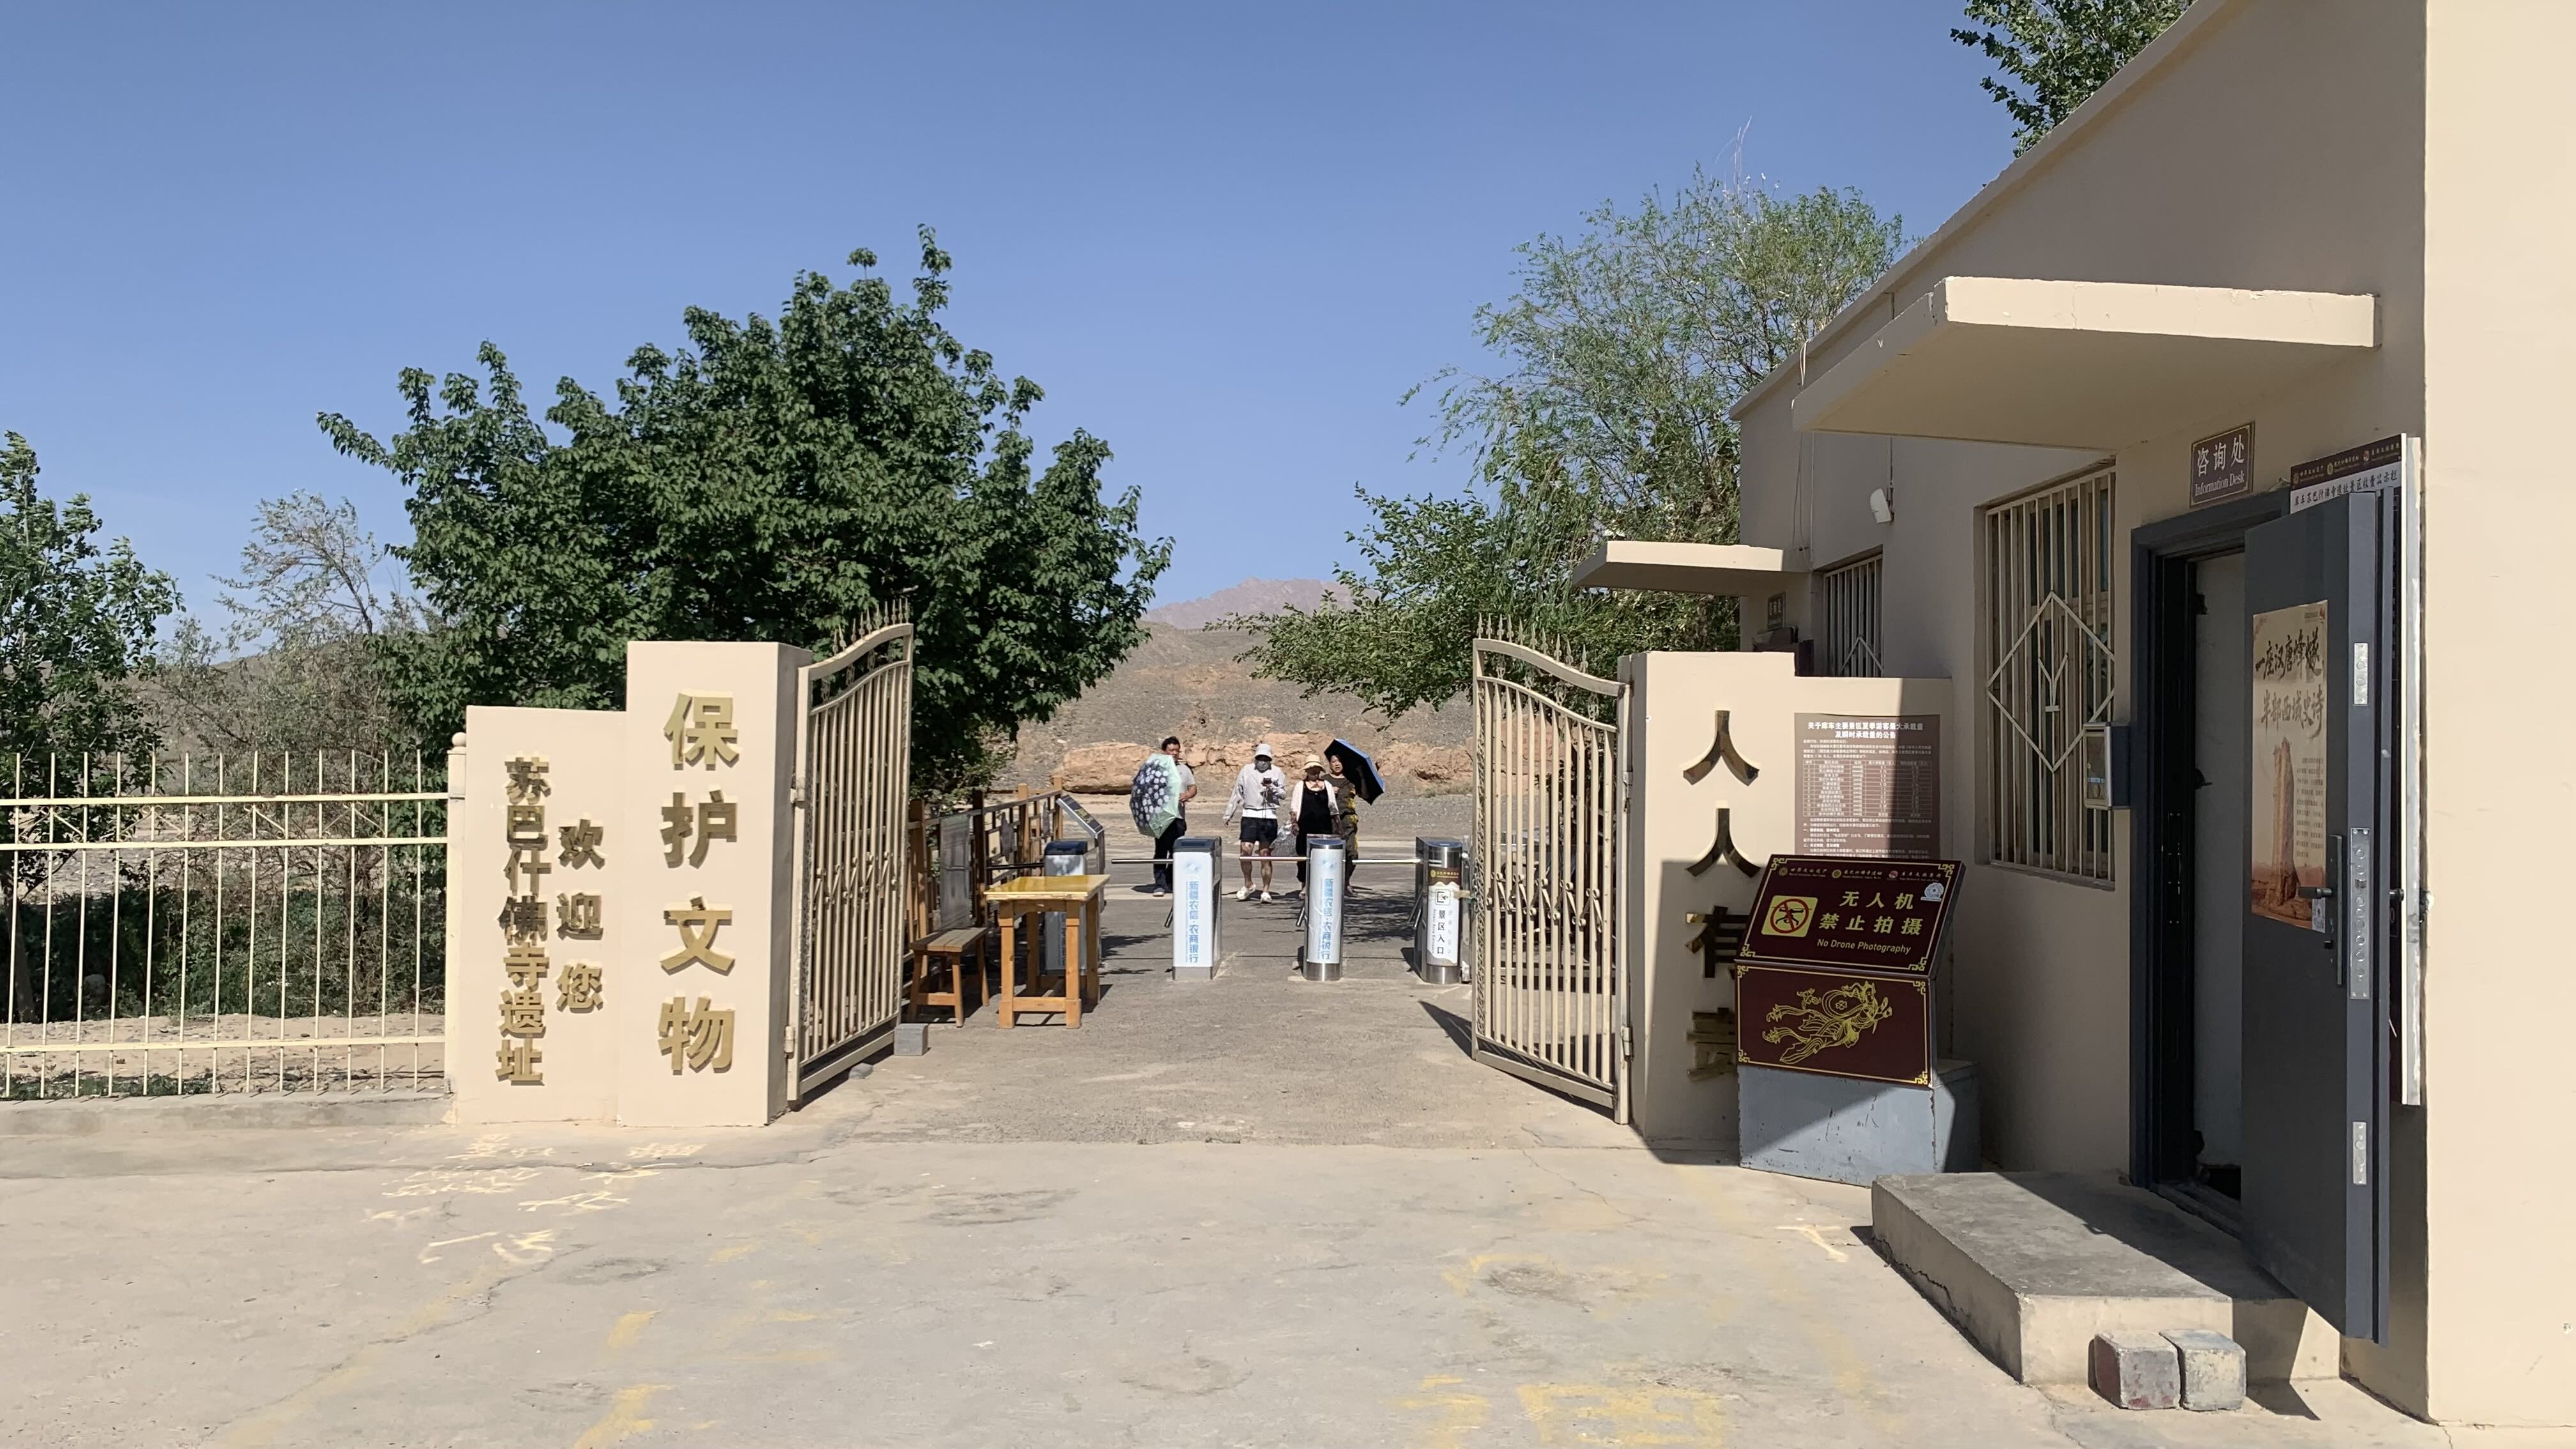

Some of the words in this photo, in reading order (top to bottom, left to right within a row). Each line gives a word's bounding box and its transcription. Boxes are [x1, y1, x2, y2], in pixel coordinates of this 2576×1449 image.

[2196, 434, 2244, 477] 咨询处
[2195, 477, 2229, 496] Information
[2230, 470, 2244, 486] Desk
[1807, 722, 1924, 731] 关于库车主要景区夏季游客最大承载量
[2261, 684, 2324, 739] 半部西域史诗
[659, 689, 742, 1075] 保护文物
[1839, 891, 1913, 910] 无人机
[496, 752, 551, 1085] 苏巴什佛寺遗址
[556, 813, 606, 1013] 欢迎您
[1437, 910, 1445, 954] 景区入口
[1819, 913, 1924, 936] 禁止拍摄
[1816, 939, 1828, 947] No
[1831, 940, 1855, 949] Drone
[1859, 940, 1911, 954] Photography
